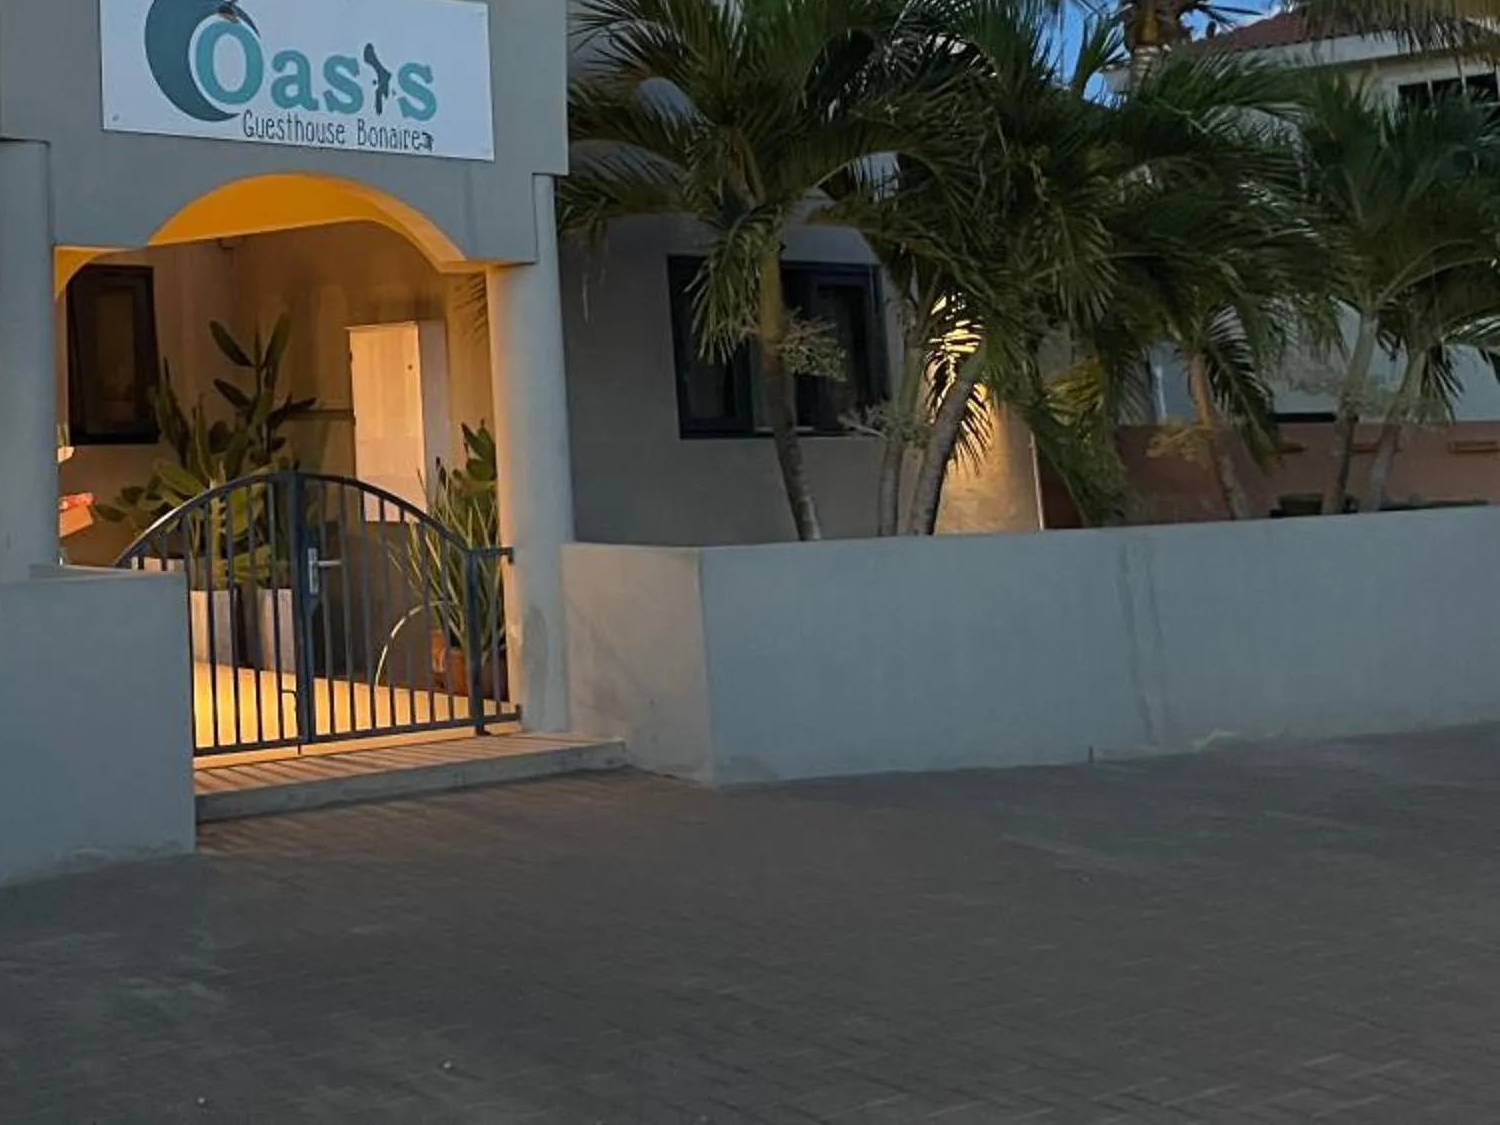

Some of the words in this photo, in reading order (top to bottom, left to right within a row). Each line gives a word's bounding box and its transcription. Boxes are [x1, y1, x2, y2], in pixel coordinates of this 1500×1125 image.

[195, 20, 437, 120] Oasis
[243, 109, 345, 144] Guesthouse
[357, 119, 421, 150] Bonaire
